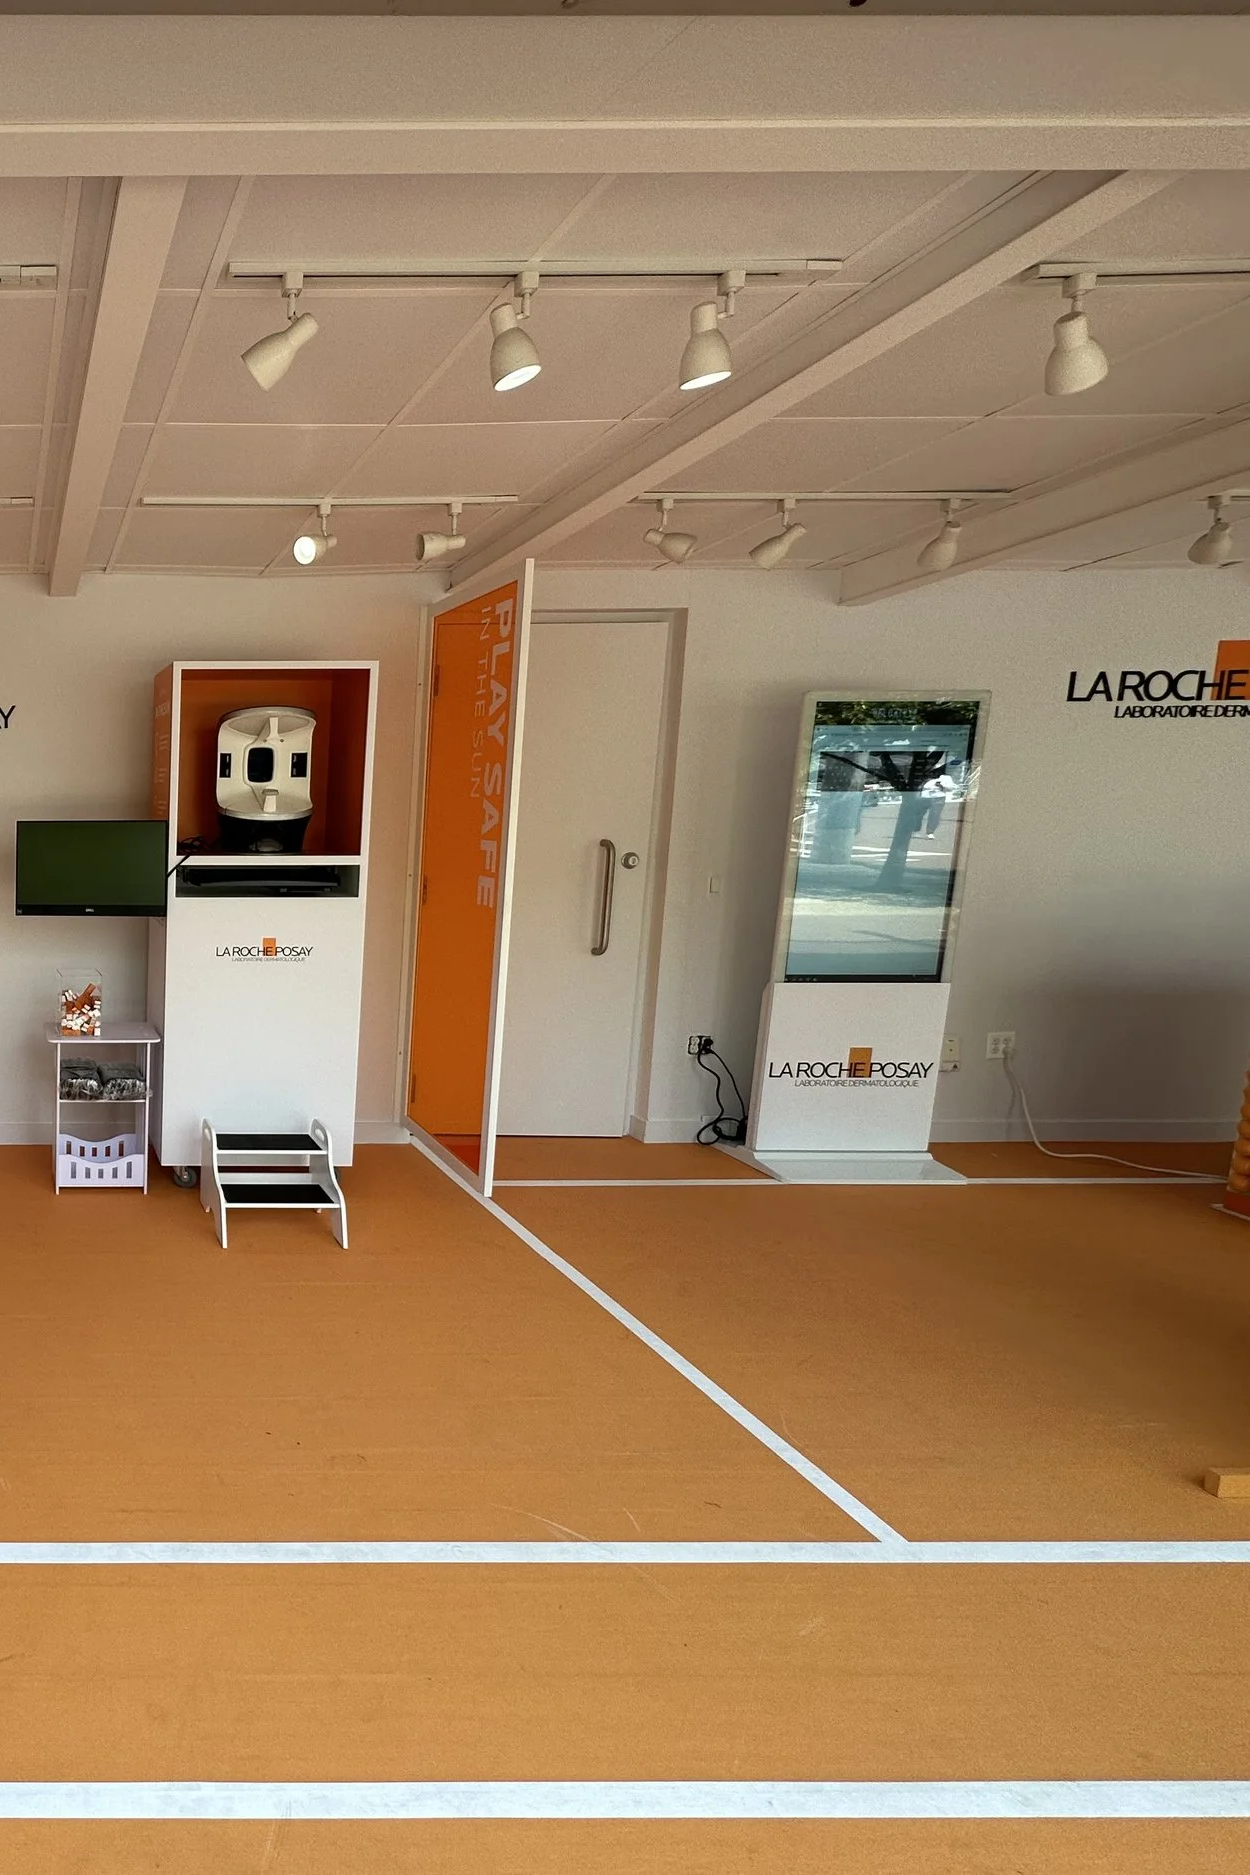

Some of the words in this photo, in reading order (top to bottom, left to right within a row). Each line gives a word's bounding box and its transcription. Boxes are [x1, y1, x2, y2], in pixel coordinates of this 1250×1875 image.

[479, 606, 492, 641] IN
[474, 650, 489, 718] THE
[487, 598, 513, 746] PLAY
[1066, 671, 1113, 702] LA
[1117, 670, 1249, 701] ROCHE
[1114, 705, 1214, 719] LABORATOIRE
[469, 730, 486, 798] SUN
[477, 762, 502, 908] SAFE
[215, 946, 230, 957] LA
[232, 946, 273, 957] ROCHE
[275, 946, 313, 957] POSAY
[768, 1062, 793, 1079] LA
[796, 1062, 865, 1078] ROCHE
[868, 1062, 934, 1078] POSAY
[795, 1079, 848, 1087] LABORATOIRE
